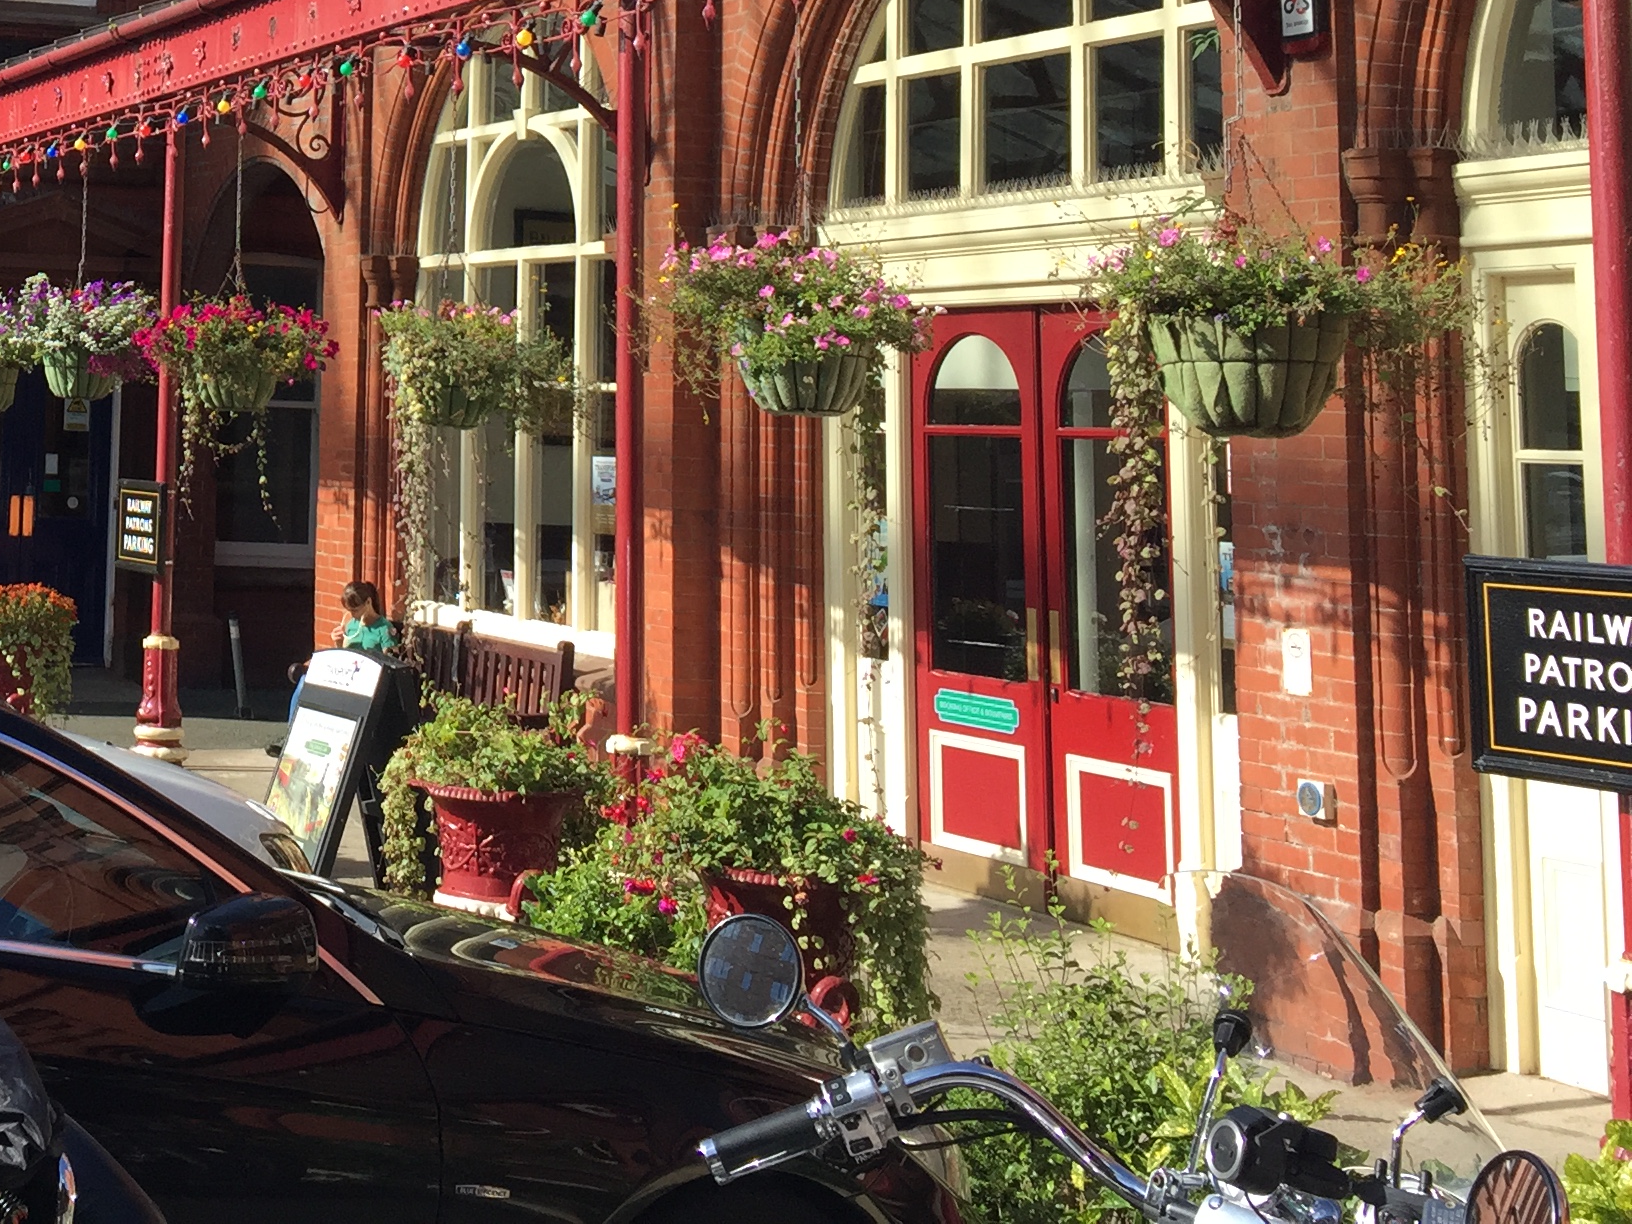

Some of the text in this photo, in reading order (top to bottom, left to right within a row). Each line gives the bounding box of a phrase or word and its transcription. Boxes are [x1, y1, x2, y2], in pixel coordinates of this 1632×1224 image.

[126, 497, 153, 514] RAILWAY
[125, 516, 153, 533] PATRONS
[123, 533, 154, 555] PARKING
